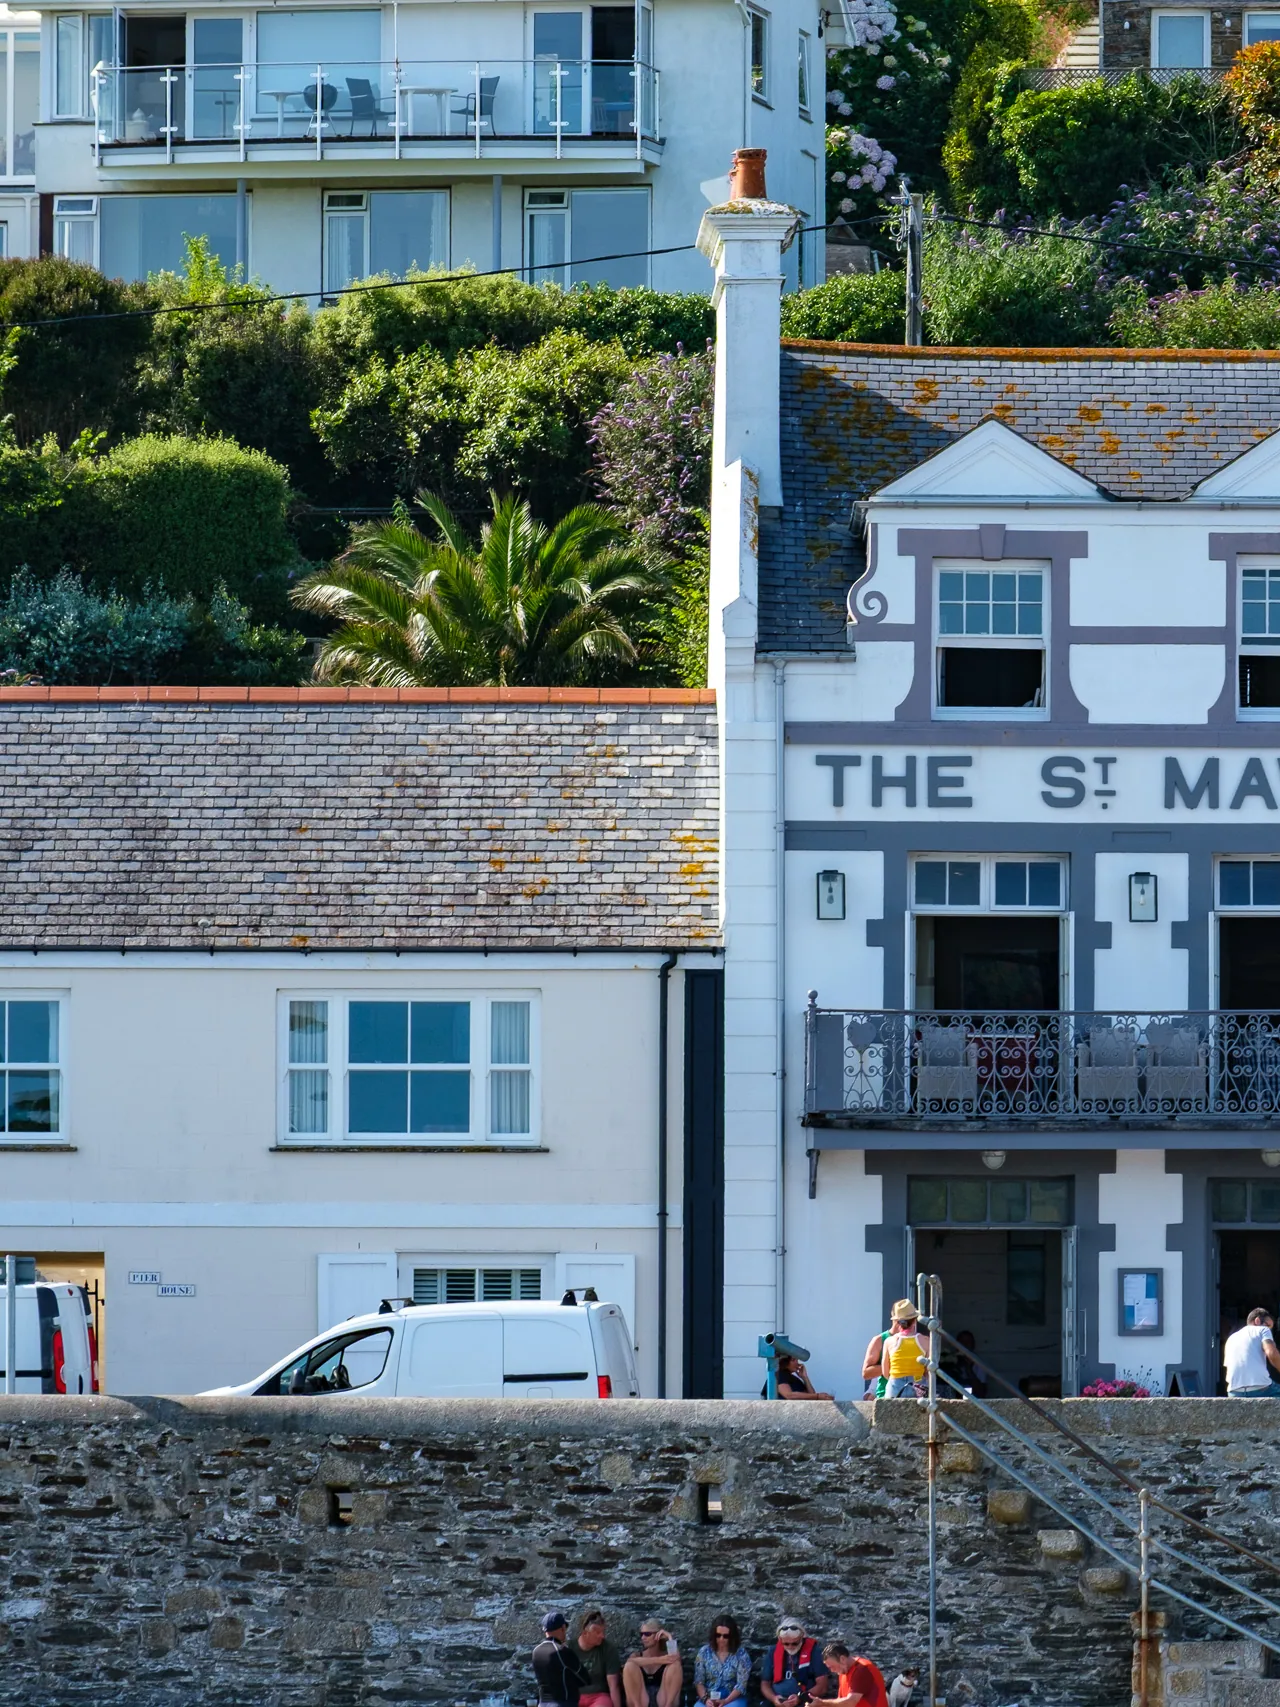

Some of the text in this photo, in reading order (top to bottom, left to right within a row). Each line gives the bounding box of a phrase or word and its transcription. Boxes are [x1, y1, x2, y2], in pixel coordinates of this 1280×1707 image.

[815, 754, 973, 808] THE
[132, 1273, 158, 1282] PIER
[161, 1286, 192, 1295] HOUSE
